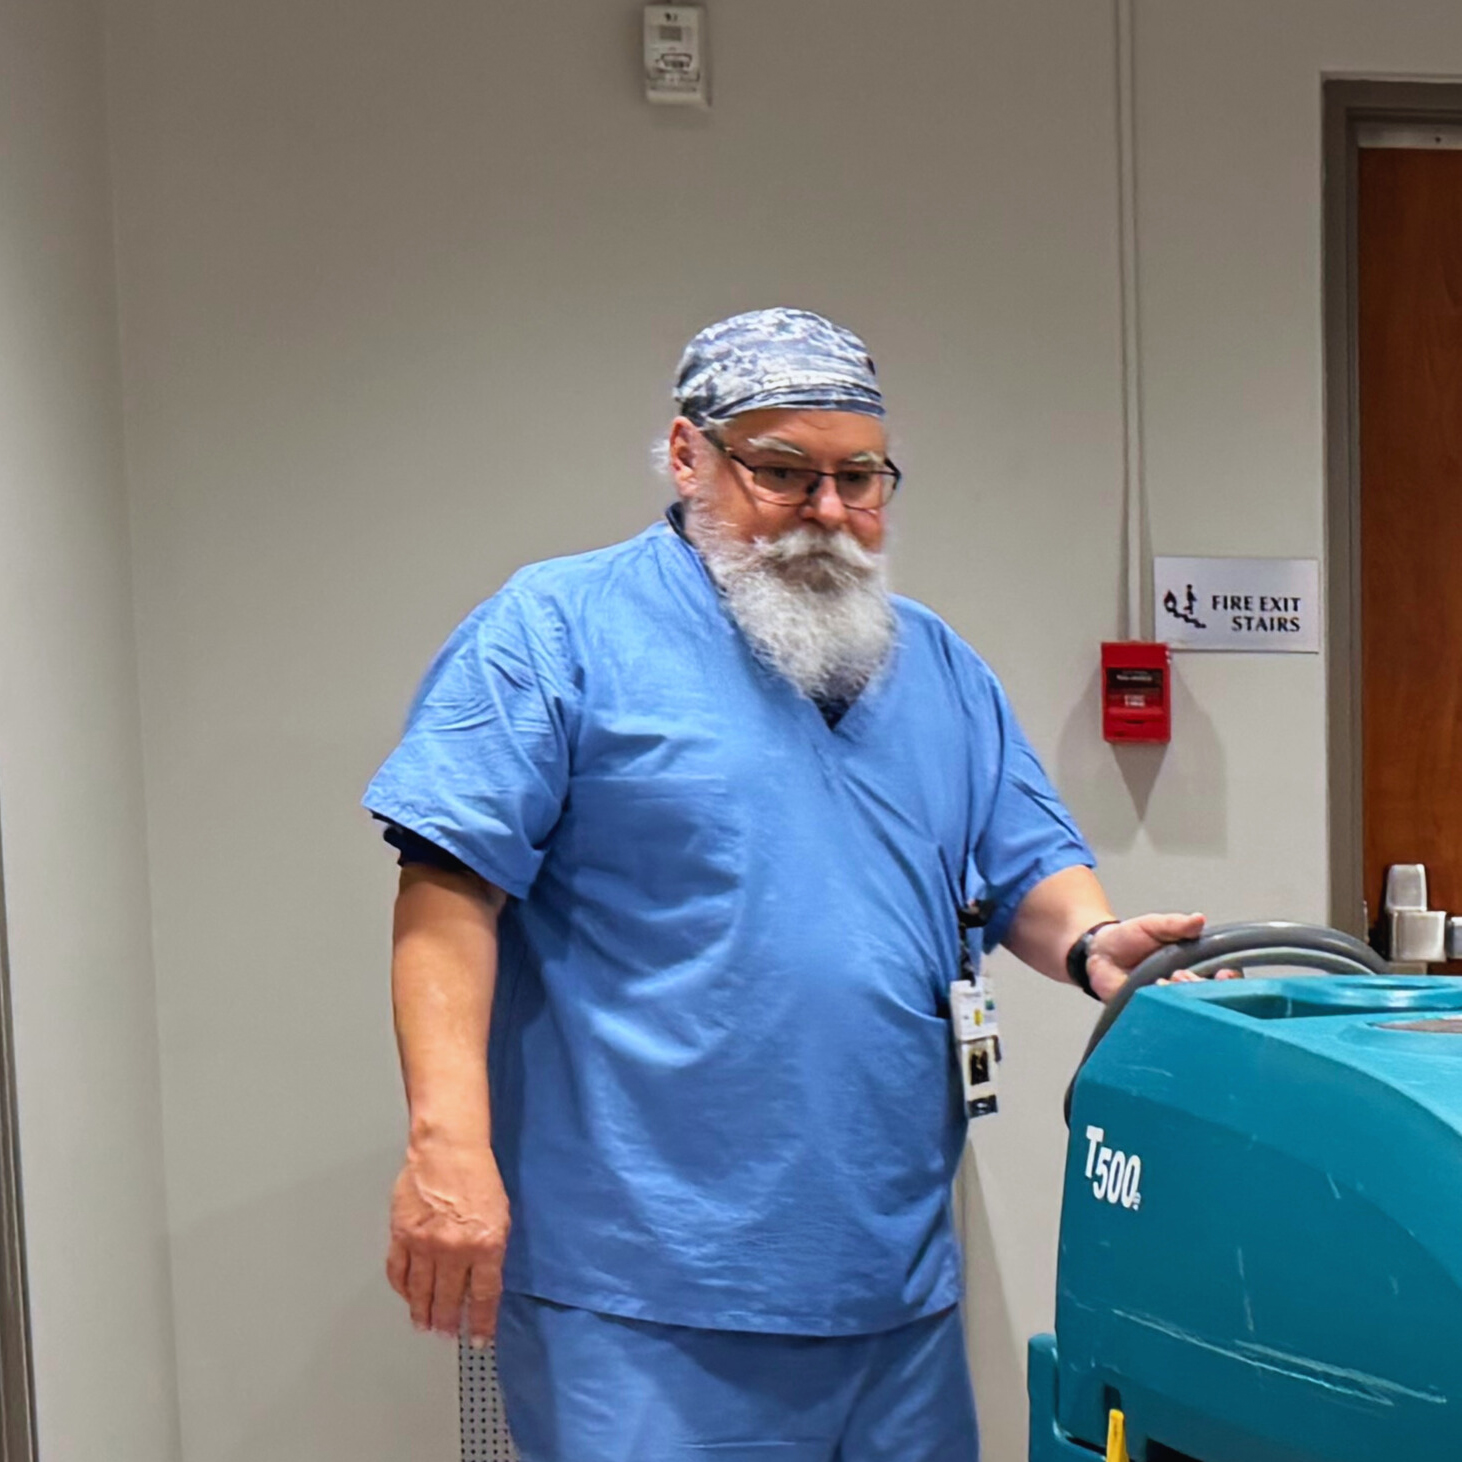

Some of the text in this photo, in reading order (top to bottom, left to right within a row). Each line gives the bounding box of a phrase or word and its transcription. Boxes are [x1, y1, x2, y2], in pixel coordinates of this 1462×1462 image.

[1211, 595, 1301, 612] FIRE EXIT
[1231, 616, 1301, 632] STAIRS
